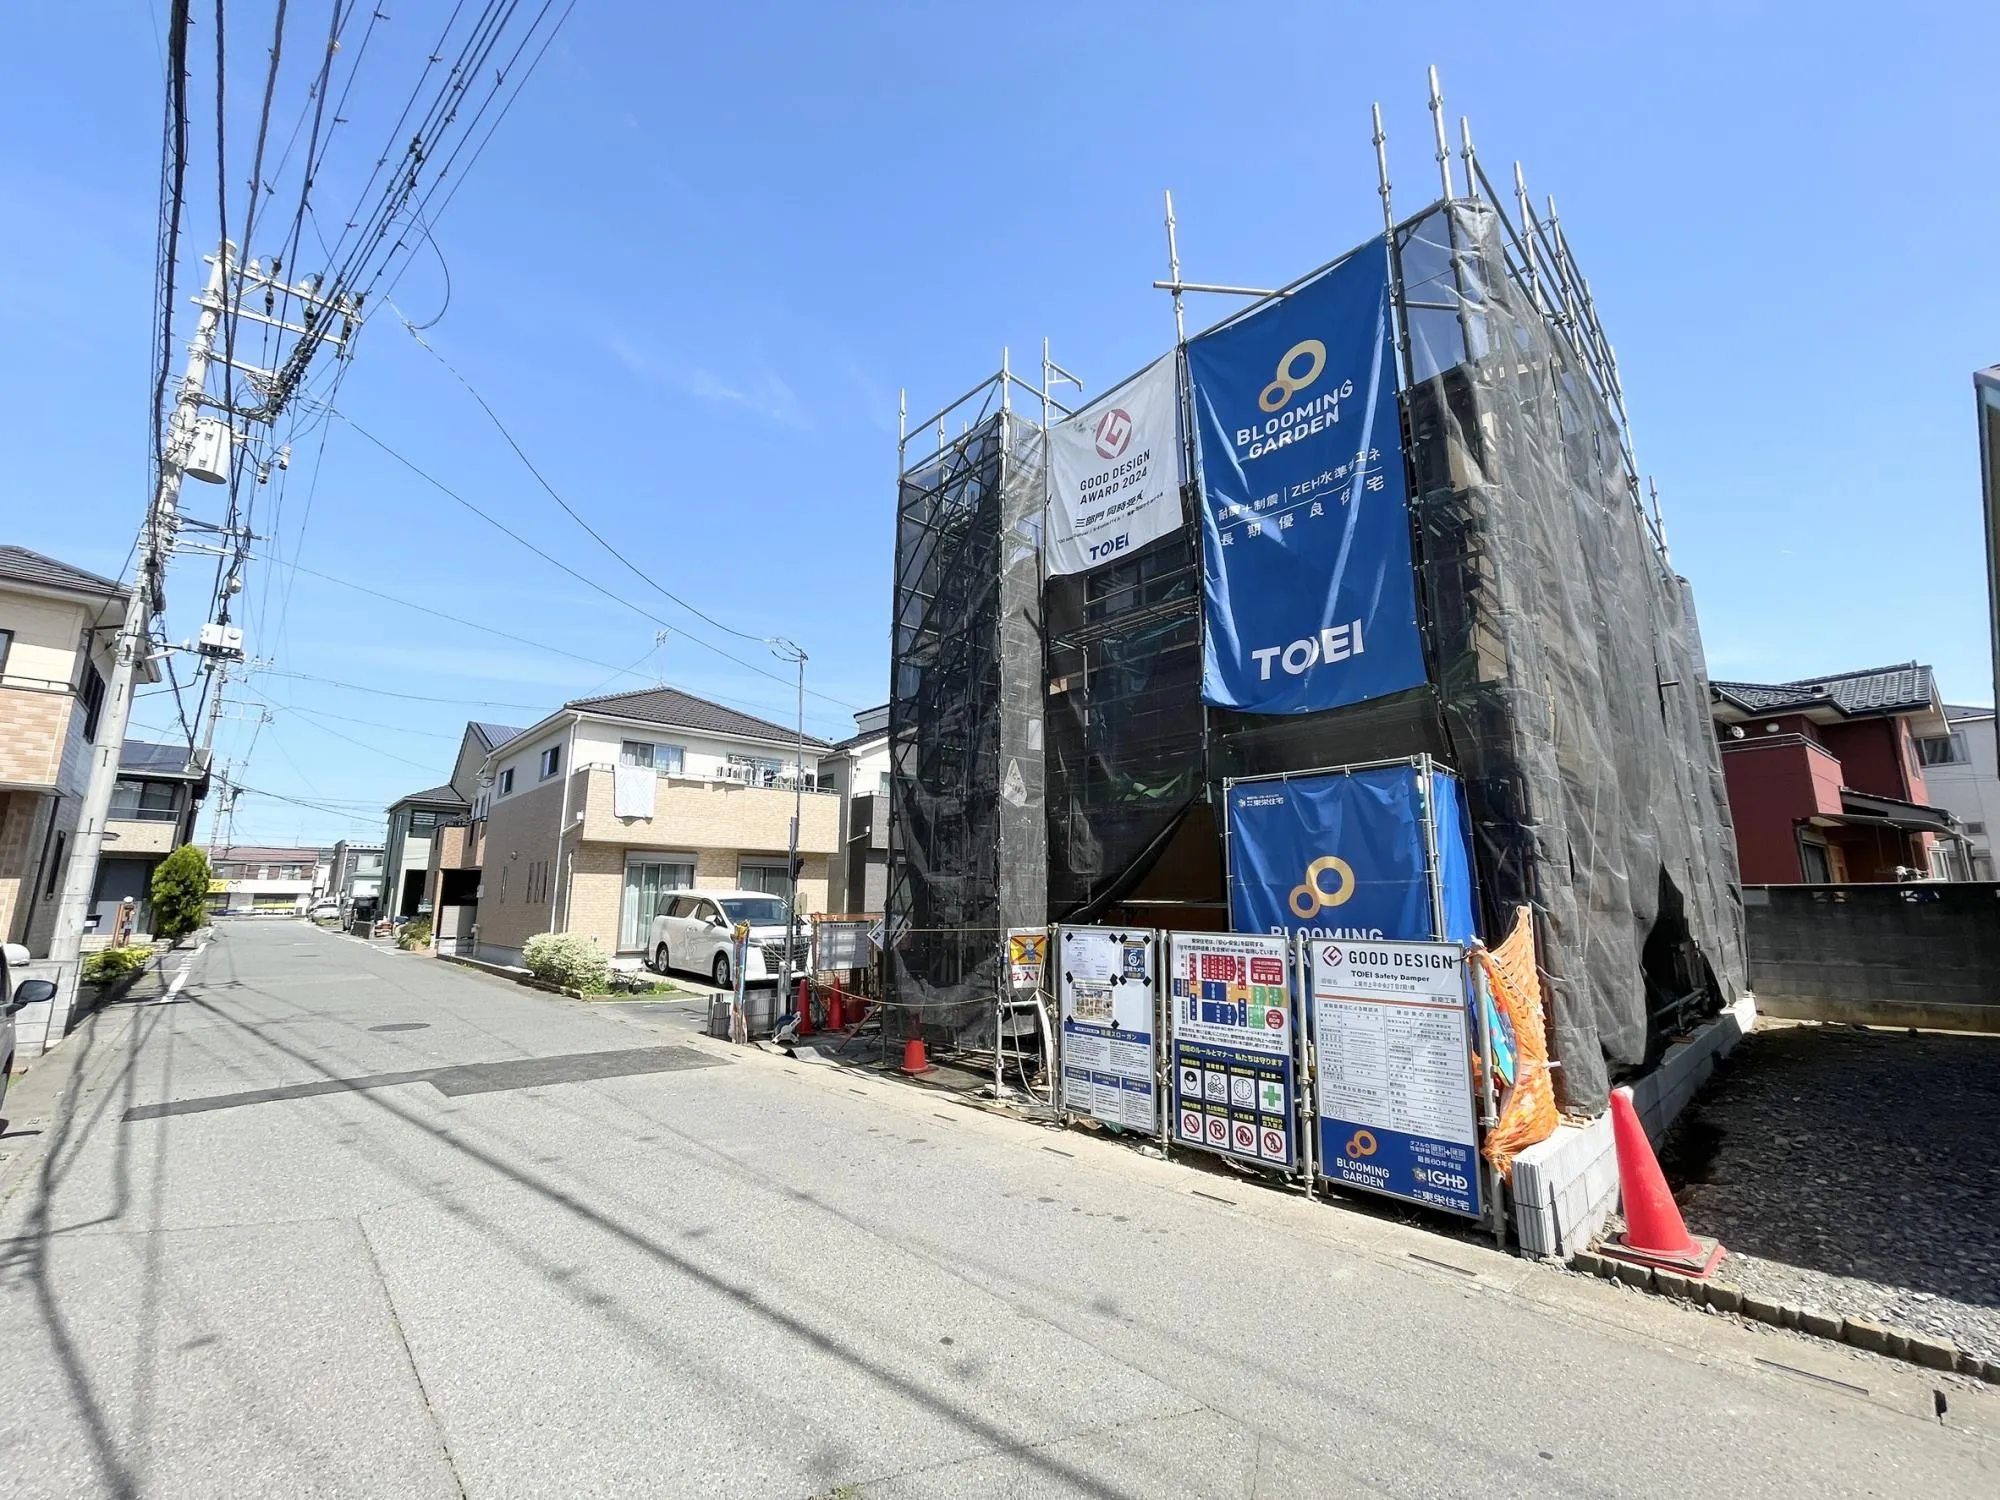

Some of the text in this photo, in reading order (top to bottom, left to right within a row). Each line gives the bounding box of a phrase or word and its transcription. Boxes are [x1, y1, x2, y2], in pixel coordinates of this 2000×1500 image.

[1236, 380, 1354, 447] BLOOMING
[1249, 406, 1340, 460] GARDEN
[1080, 449, 1150, 491] GOOD DESIGN
[1080, 482, 1119, 505] AWARD
[1122, 466, 1147, 489] 2024
[1089, 532, 1129, 560] TOEI
[1252, 618, 1365, 681] TOEI
[1349, 950, 1453, 969] GOOD DESIGN
[1351, 970, 1430, 984] TOEI Safety Damper
[1100, 1029, 1137, 1041] スローガン
[1337, 1157, 1390, 1179] BLOOMING
[1343, 1170, 1385, 1189] GARDEN
[1427, 1169, 1468, 1190] IGHD
